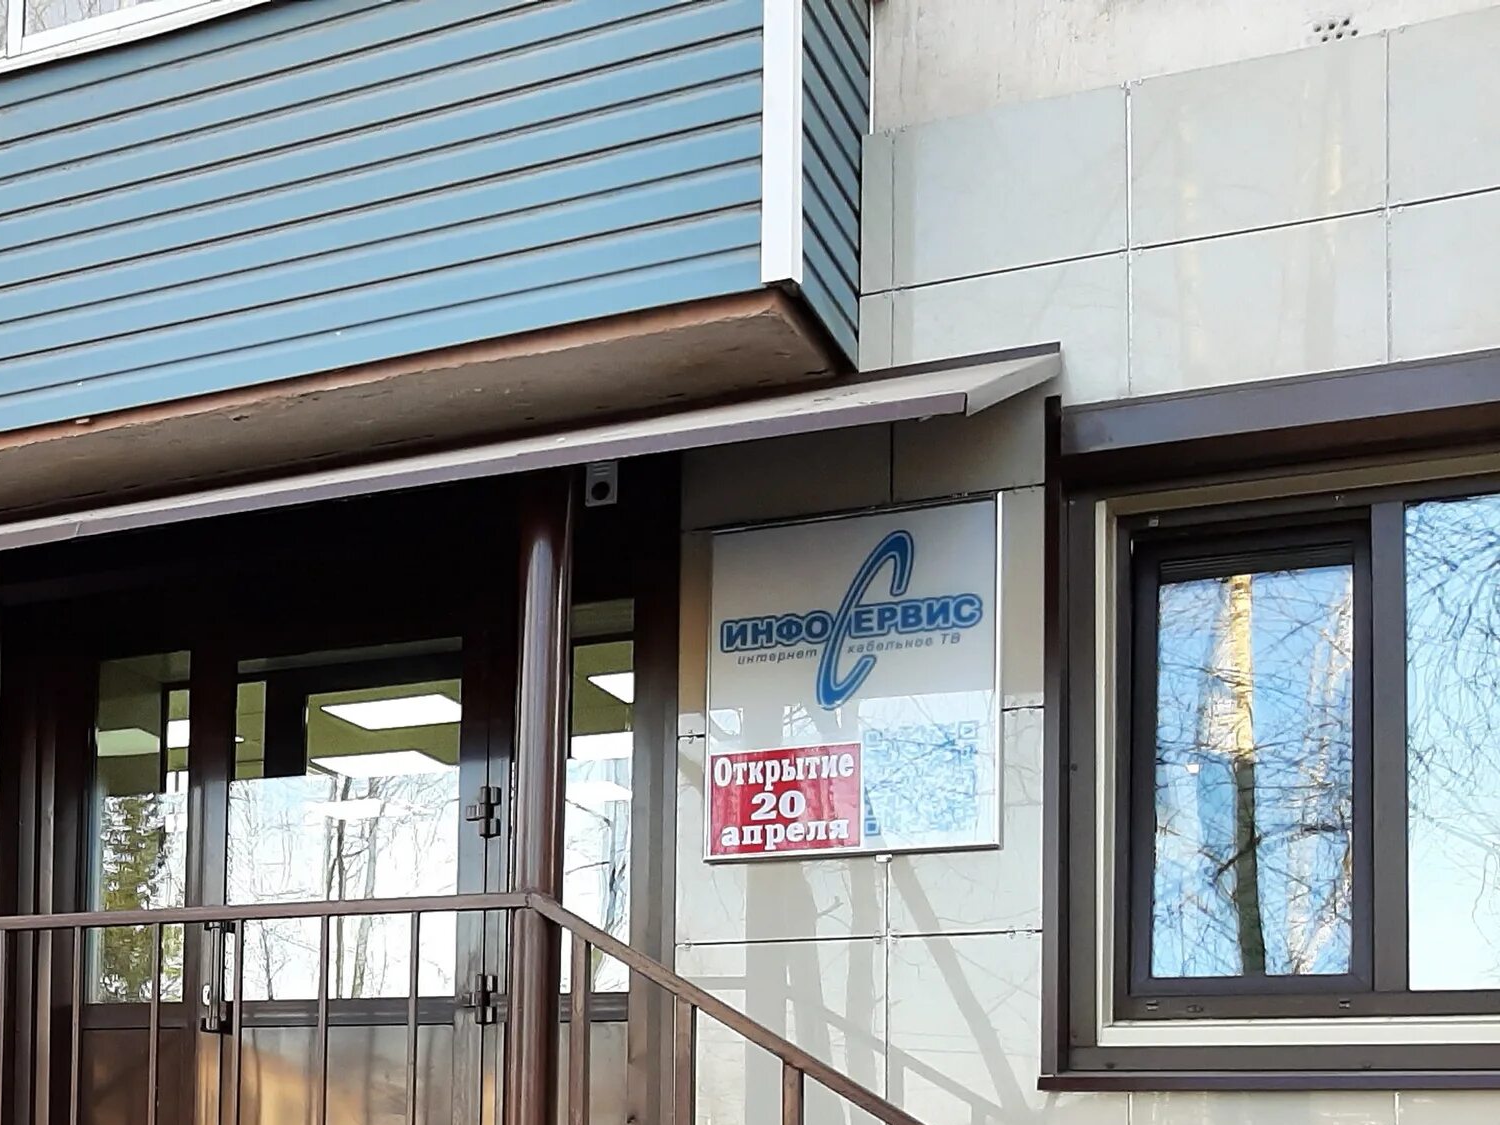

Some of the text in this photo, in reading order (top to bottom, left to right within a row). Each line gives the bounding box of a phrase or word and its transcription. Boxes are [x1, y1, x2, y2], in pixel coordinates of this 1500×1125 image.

[737, 632, 962, 665] интернет кабельное ТВ
[713, 752, 854, 791] Открытие
[750, 791, 806, 821] 20
[721, 818, 850, 850] апреля
